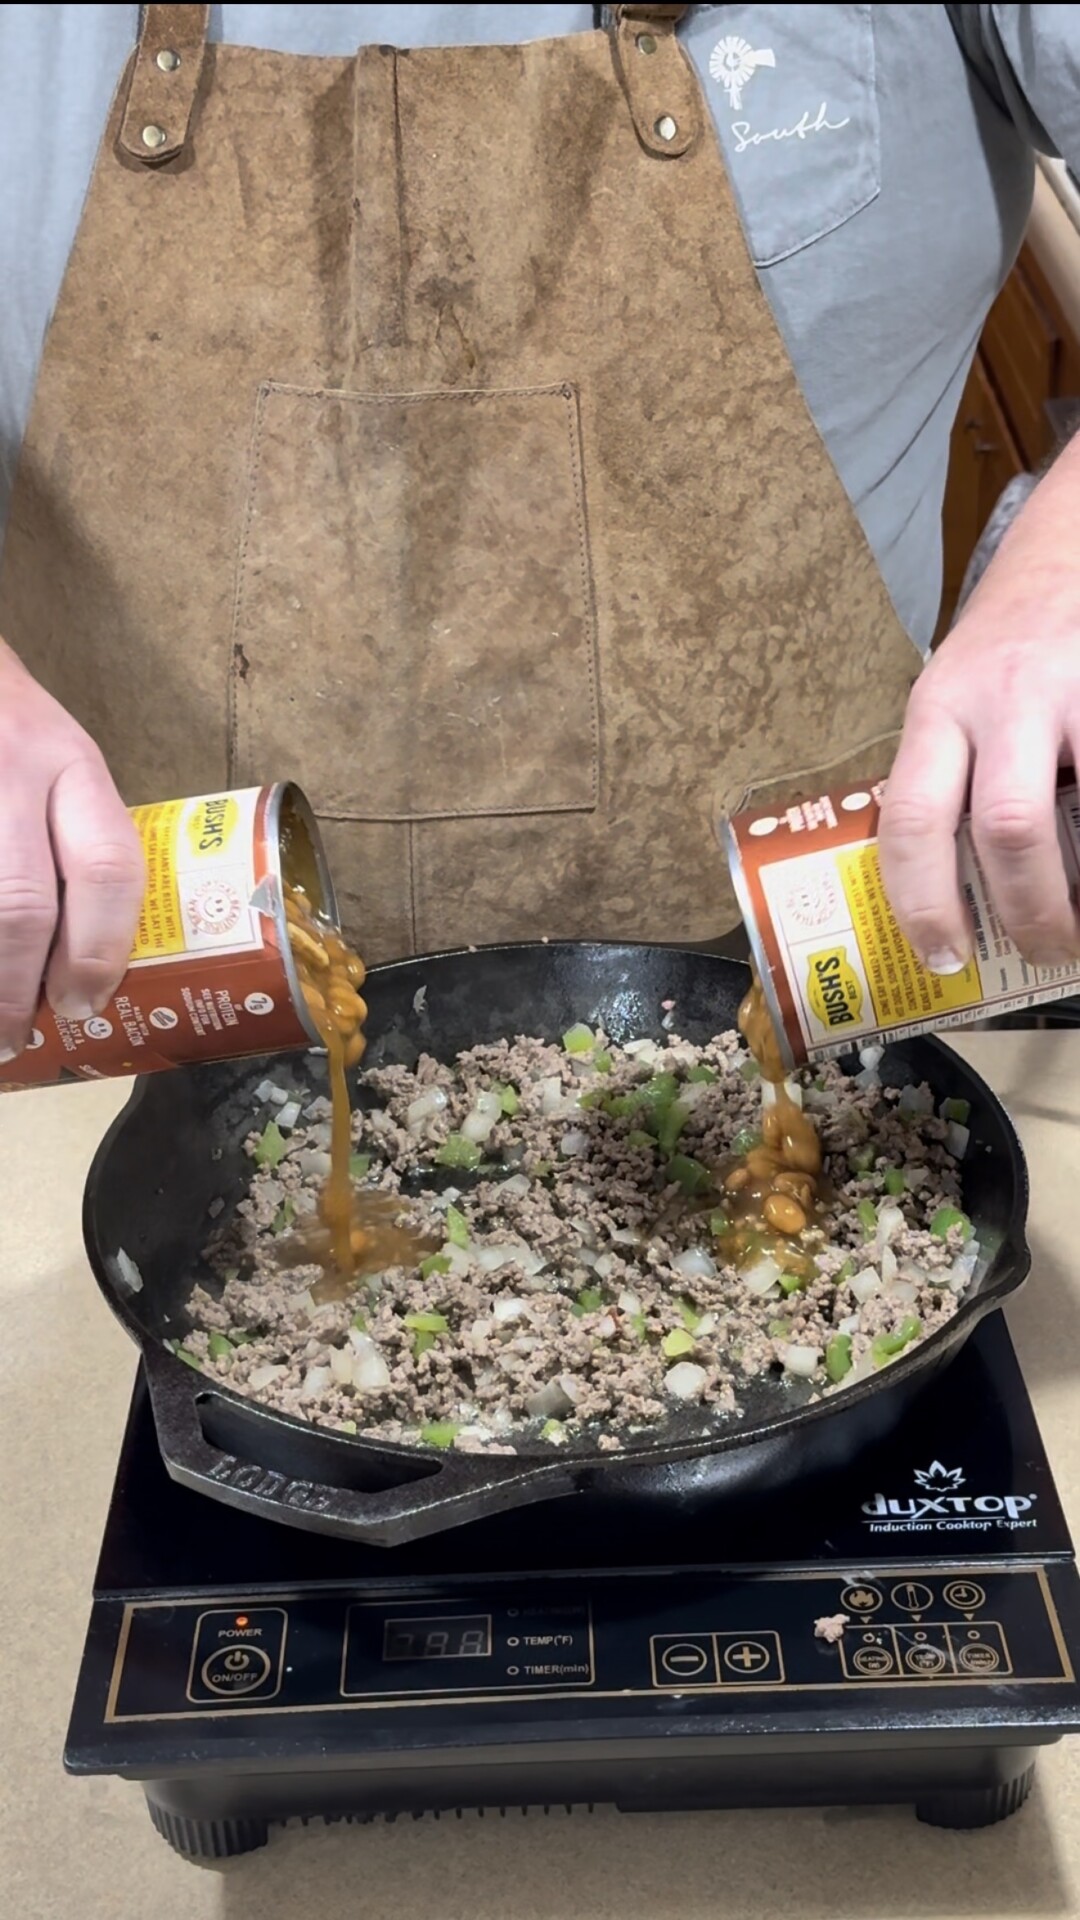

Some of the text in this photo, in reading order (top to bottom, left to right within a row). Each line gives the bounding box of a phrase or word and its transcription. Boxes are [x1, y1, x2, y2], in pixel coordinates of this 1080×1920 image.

[731, 101, 851, 152] South
[199, 798, 228, 850] BUSH'S
[161, 874, 169, 888] ARE
[162, 892, 171, 912] BEST
[865, 887, 876, 900] WE
[151, 914, 160, 929] SAY
[165, 915, 175, 938] WITH
[857, 909, 869, 926] ARE
[154, 932, 163, 948] THE
[860, 925, 876, 956] BEANS
[889, 926, 907, 963] FLAVORS
[880, 946, 891, 961] SAY
[868, 957, 883, 984] BAKED
[884, 962, 898, 984] SOME
[815, 956, 855, 1026] BUSH'S
[845, 980, 858, 1000] BEST
[875, 984, 887, 998] SAY
[898, 963, 919, 1011] CONTRASTING
[916, 975, 927, 991] AND
[930, 977, 943, 999] BRING
[201, 988, 212, 1000] SEE
[249, 997, 268, 1010] 7g
[215, 989, 239, 1026] PROTEIN
[879, 998, 892, 1016] SOME
[114, 996, 146, 1047] REAL BACON
[53, 1014, 77, 1052] DELICIOUS
[870, 1519, 1037, 1532] Induction Cooktop Expert
[218, 1628, 262, 1638] POWER
[212, 1673, 258, 1683] ON/OFF
[523, 1663, 590, 1675] TIMER(min)
